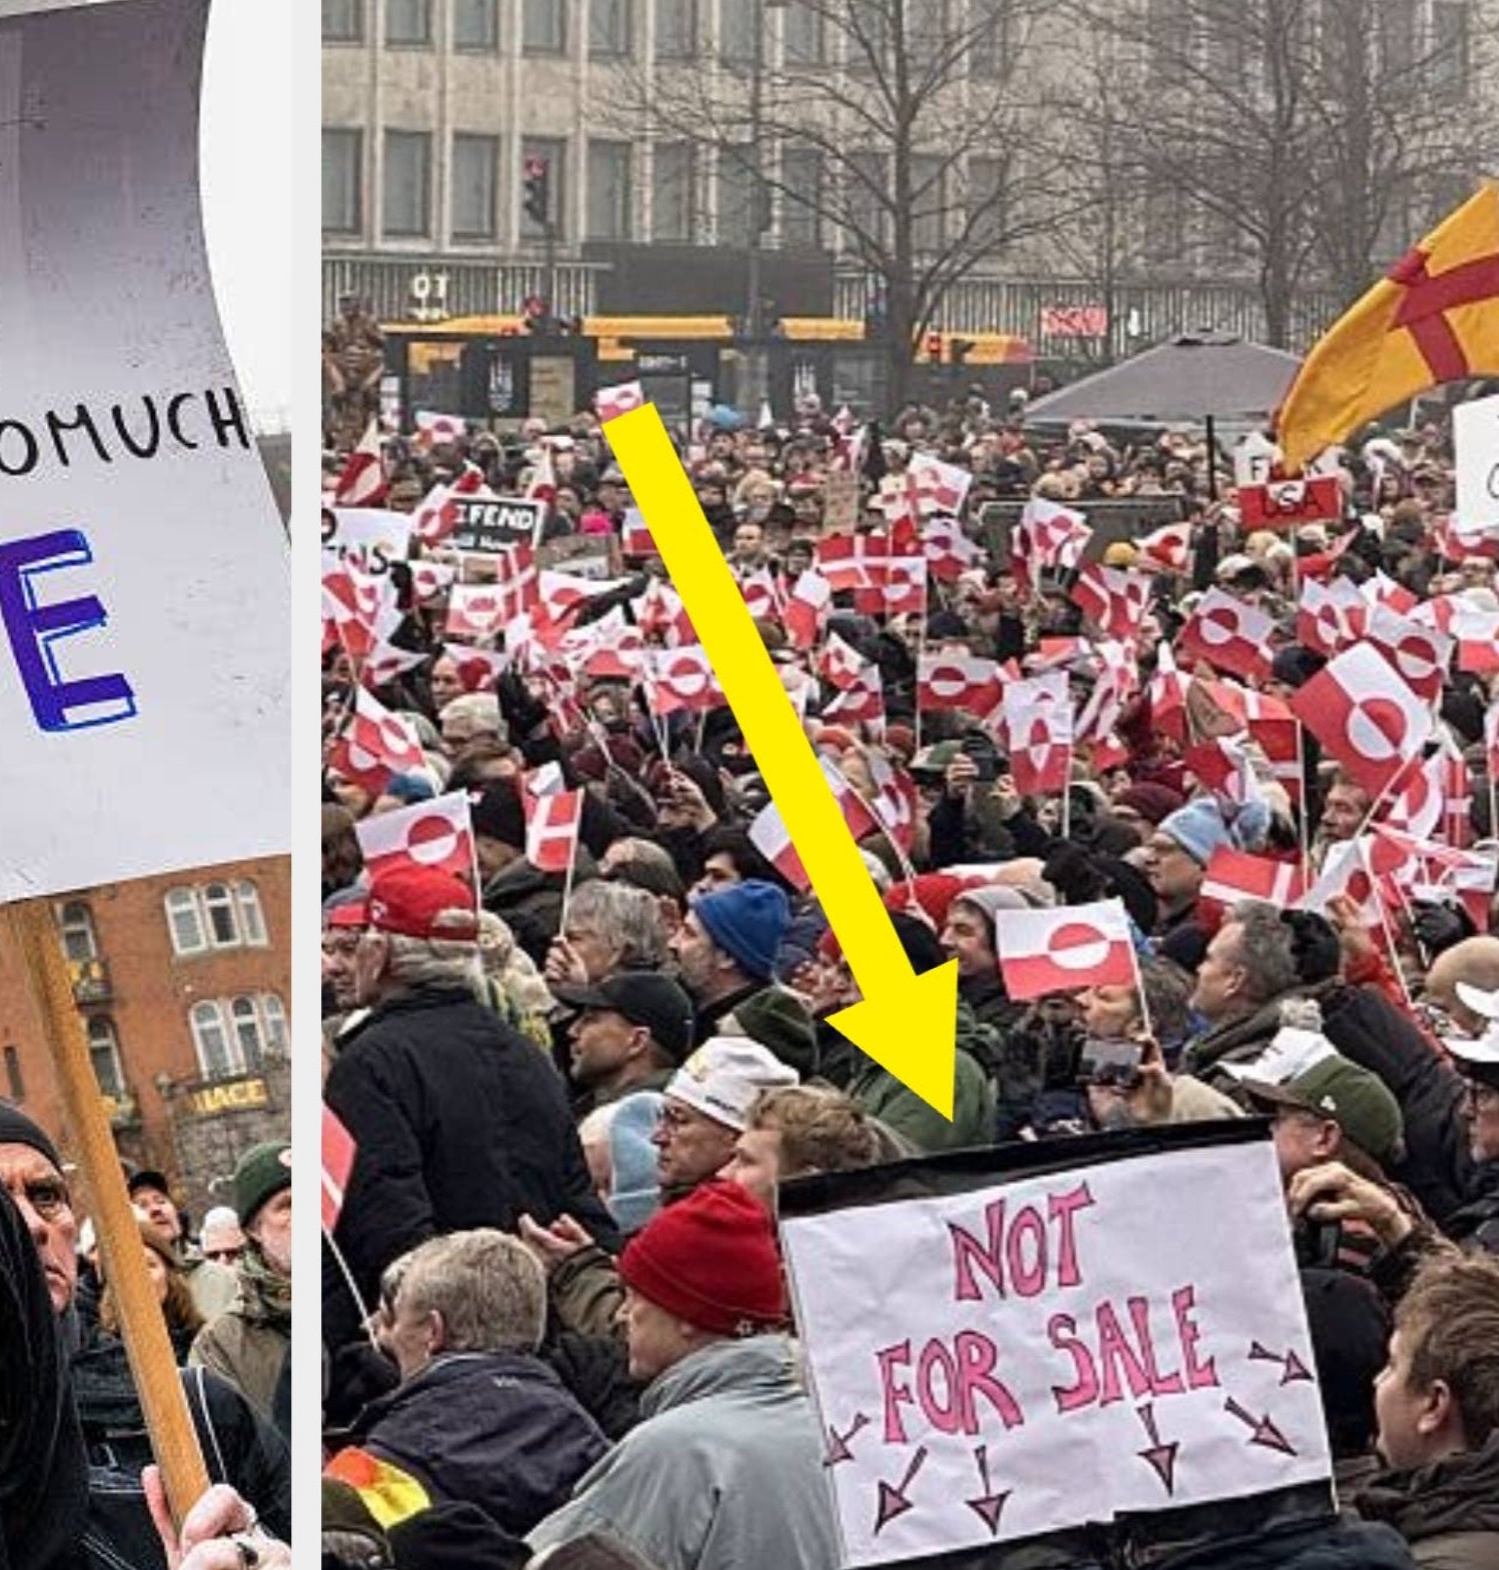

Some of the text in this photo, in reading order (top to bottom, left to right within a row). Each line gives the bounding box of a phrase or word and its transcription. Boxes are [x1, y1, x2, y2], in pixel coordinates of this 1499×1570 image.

[1262, 484, 1324, 516] USA
[946, 1181, 1096, 1300] NOT
[876, 1285, 1221, 1443] FOR SALE
